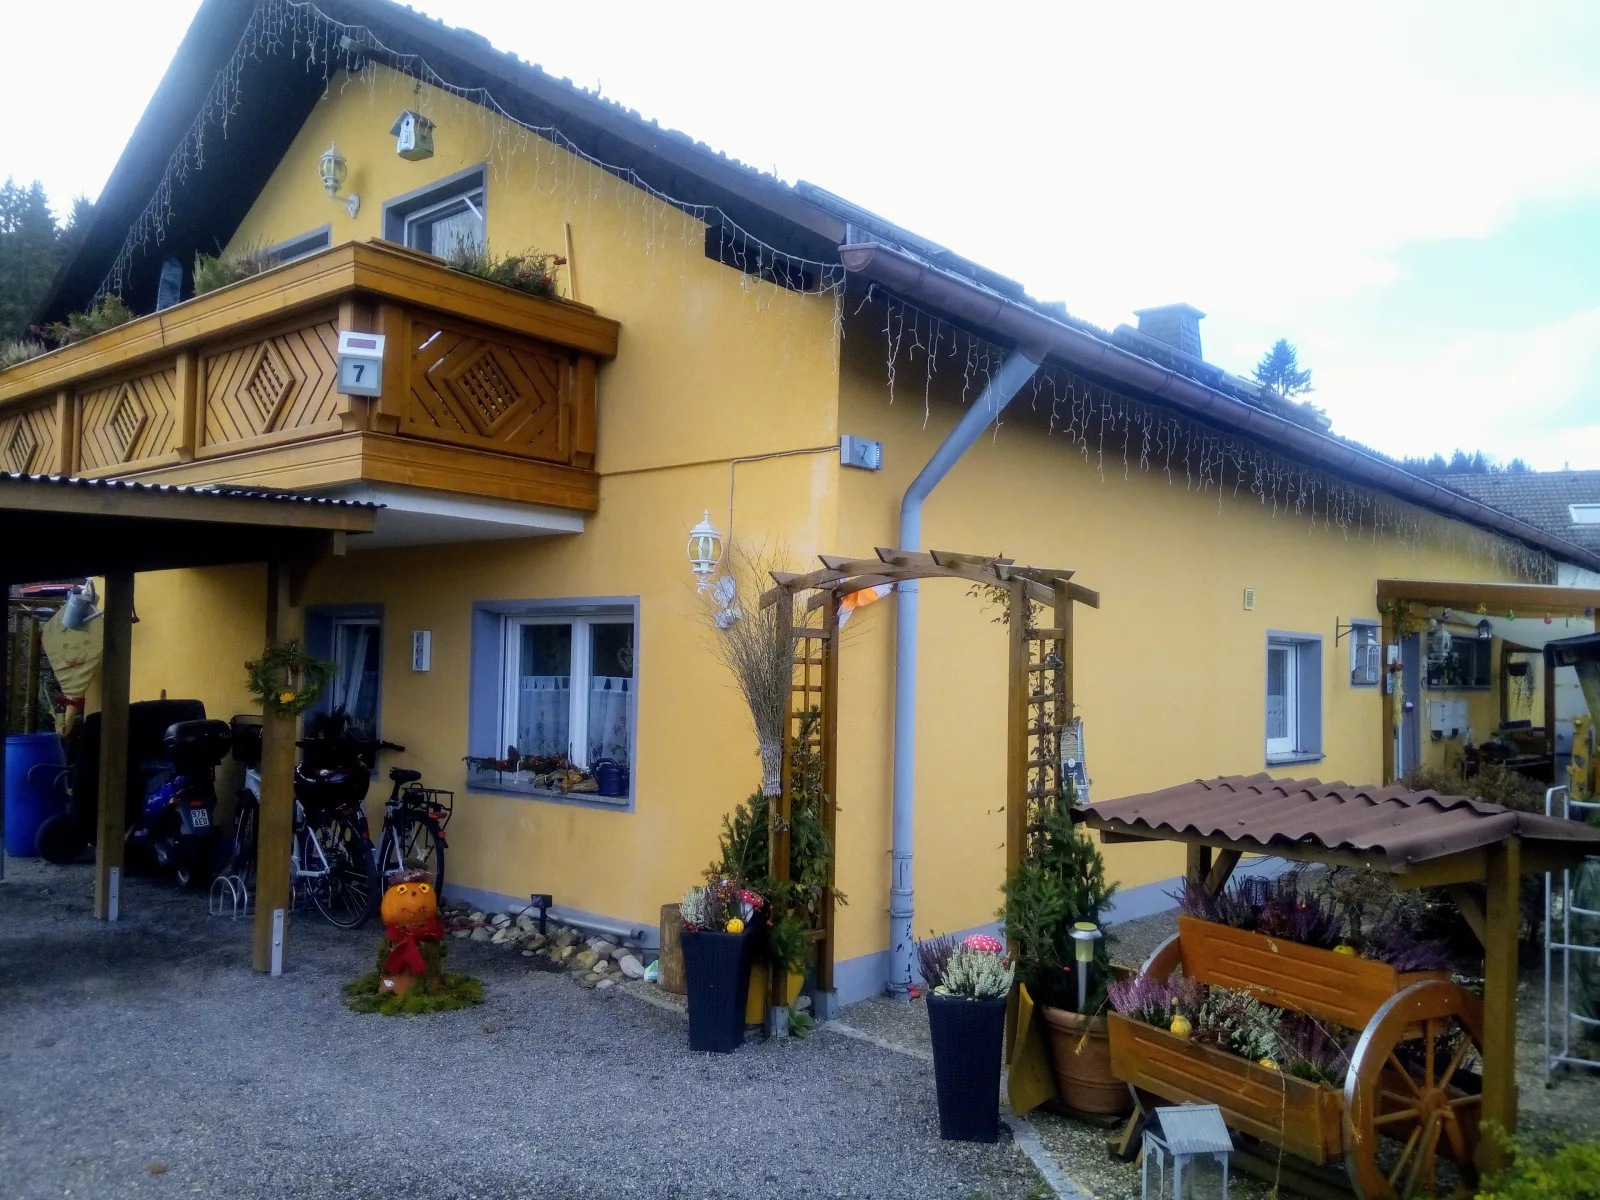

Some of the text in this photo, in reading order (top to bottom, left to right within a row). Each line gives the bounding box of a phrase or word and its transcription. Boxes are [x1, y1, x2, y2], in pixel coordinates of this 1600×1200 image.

[353, 364, 364, 382] 7
[861, 444, 868, 460] 7
[191, 809, 206, 818] 976
